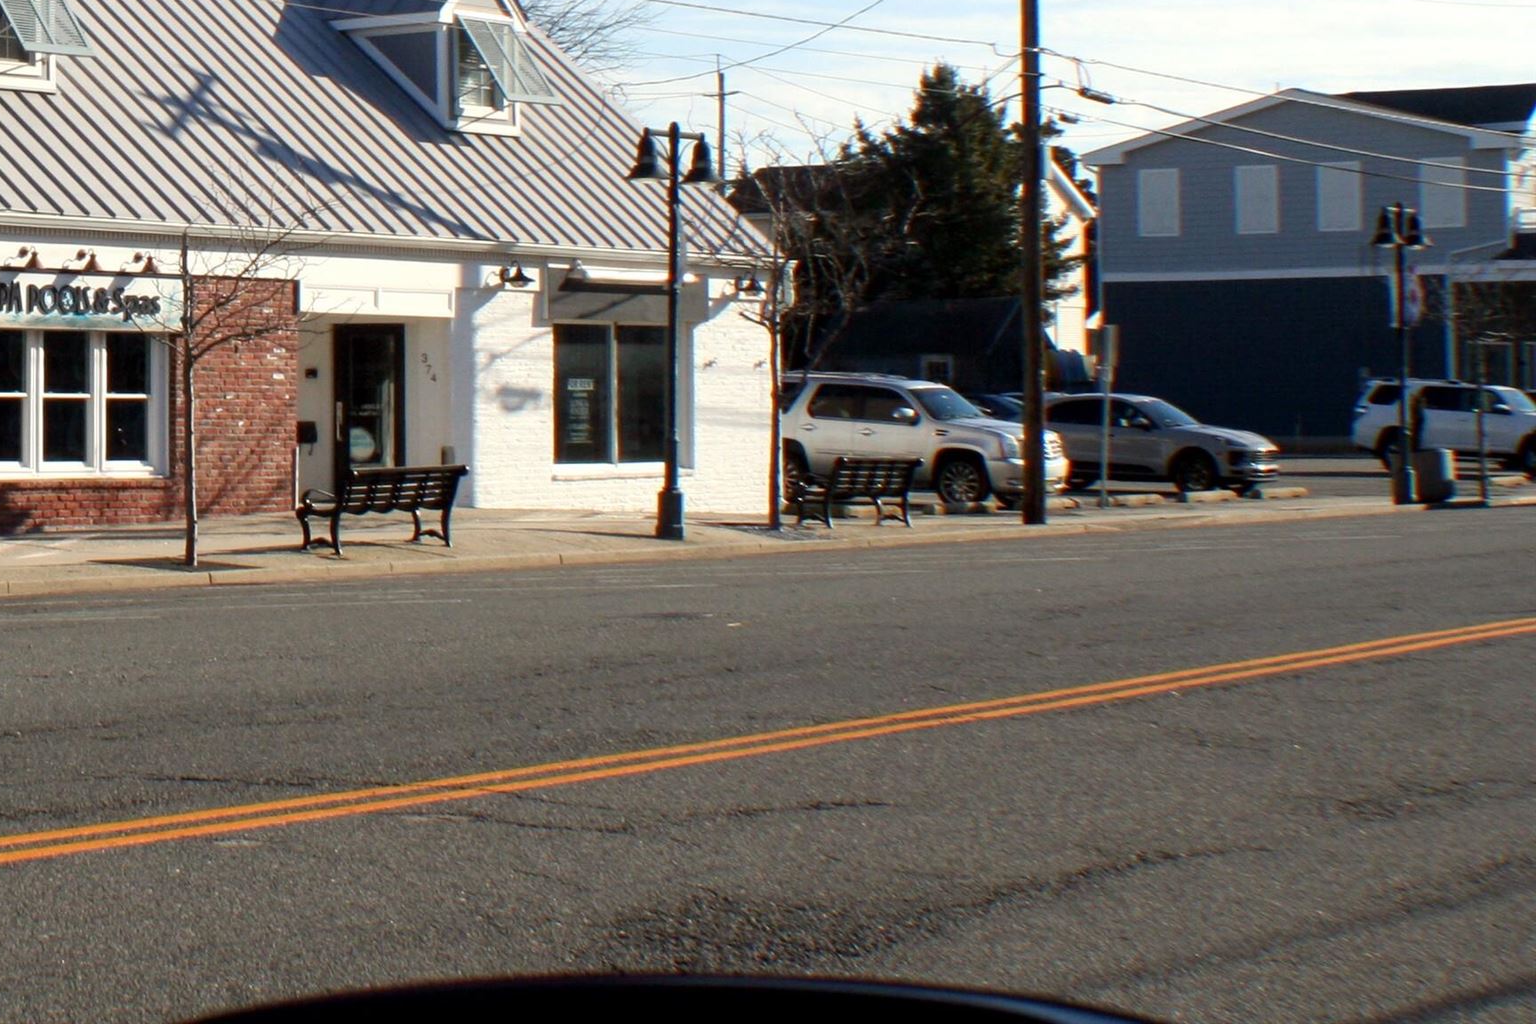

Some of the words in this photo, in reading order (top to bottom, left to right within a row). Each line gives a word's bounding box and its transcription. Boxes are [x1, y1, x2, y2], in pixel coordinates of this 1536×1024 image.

[26, 284, 91, 316] POOLS
[93, 287, 110, 315] &
[112, 286, 161, 322] Spas
